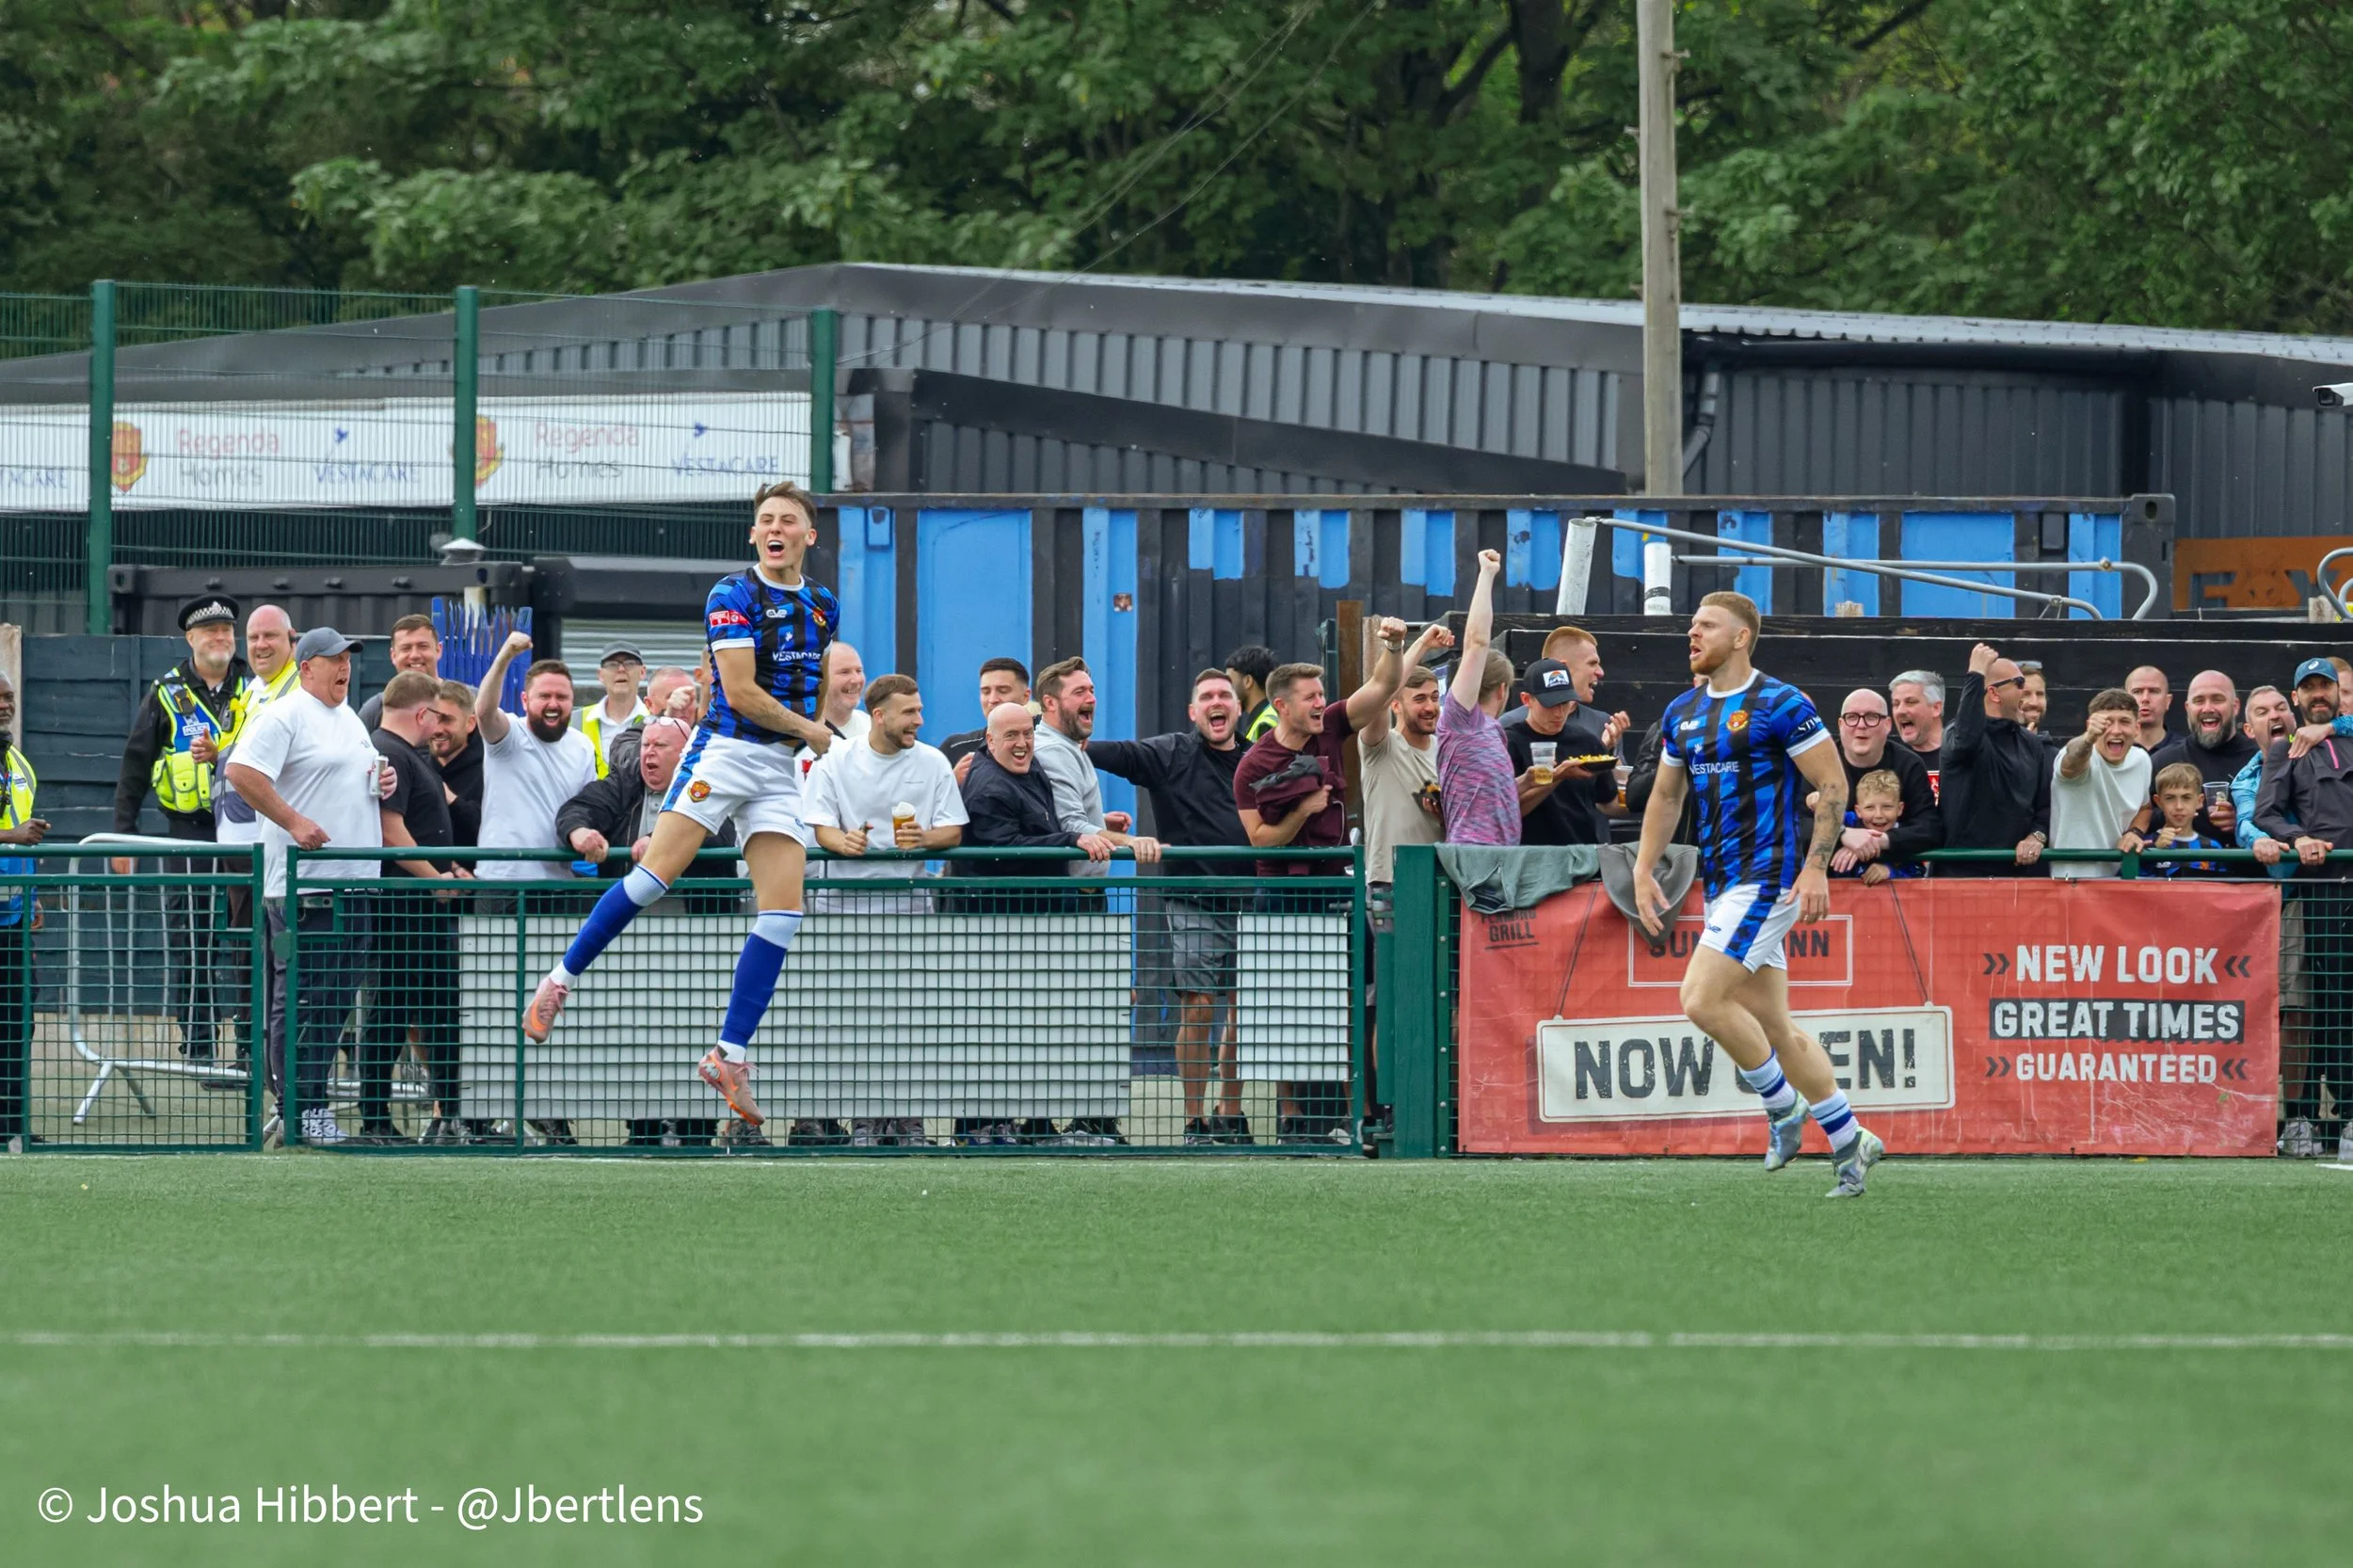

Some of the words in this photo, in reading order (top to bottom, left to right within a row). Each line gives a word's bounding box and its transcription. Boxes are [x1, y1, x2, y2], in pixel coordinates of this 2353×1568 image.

[1689, 760, 1740, 775] VESTACARE
[1489, 921, 1536, 942] GRILL
[2016, 945, 2105, 984] NEW
[2117, 945, 2218, 984] LOOK
[1993, 1000, 2115, 1038] GREAT
[2122, 1001, 2240, 1039] TIMES
[1574, 1035, 1714, 1100] NOW
[2015, 1052, 2217, 1083] GUARANTEED
